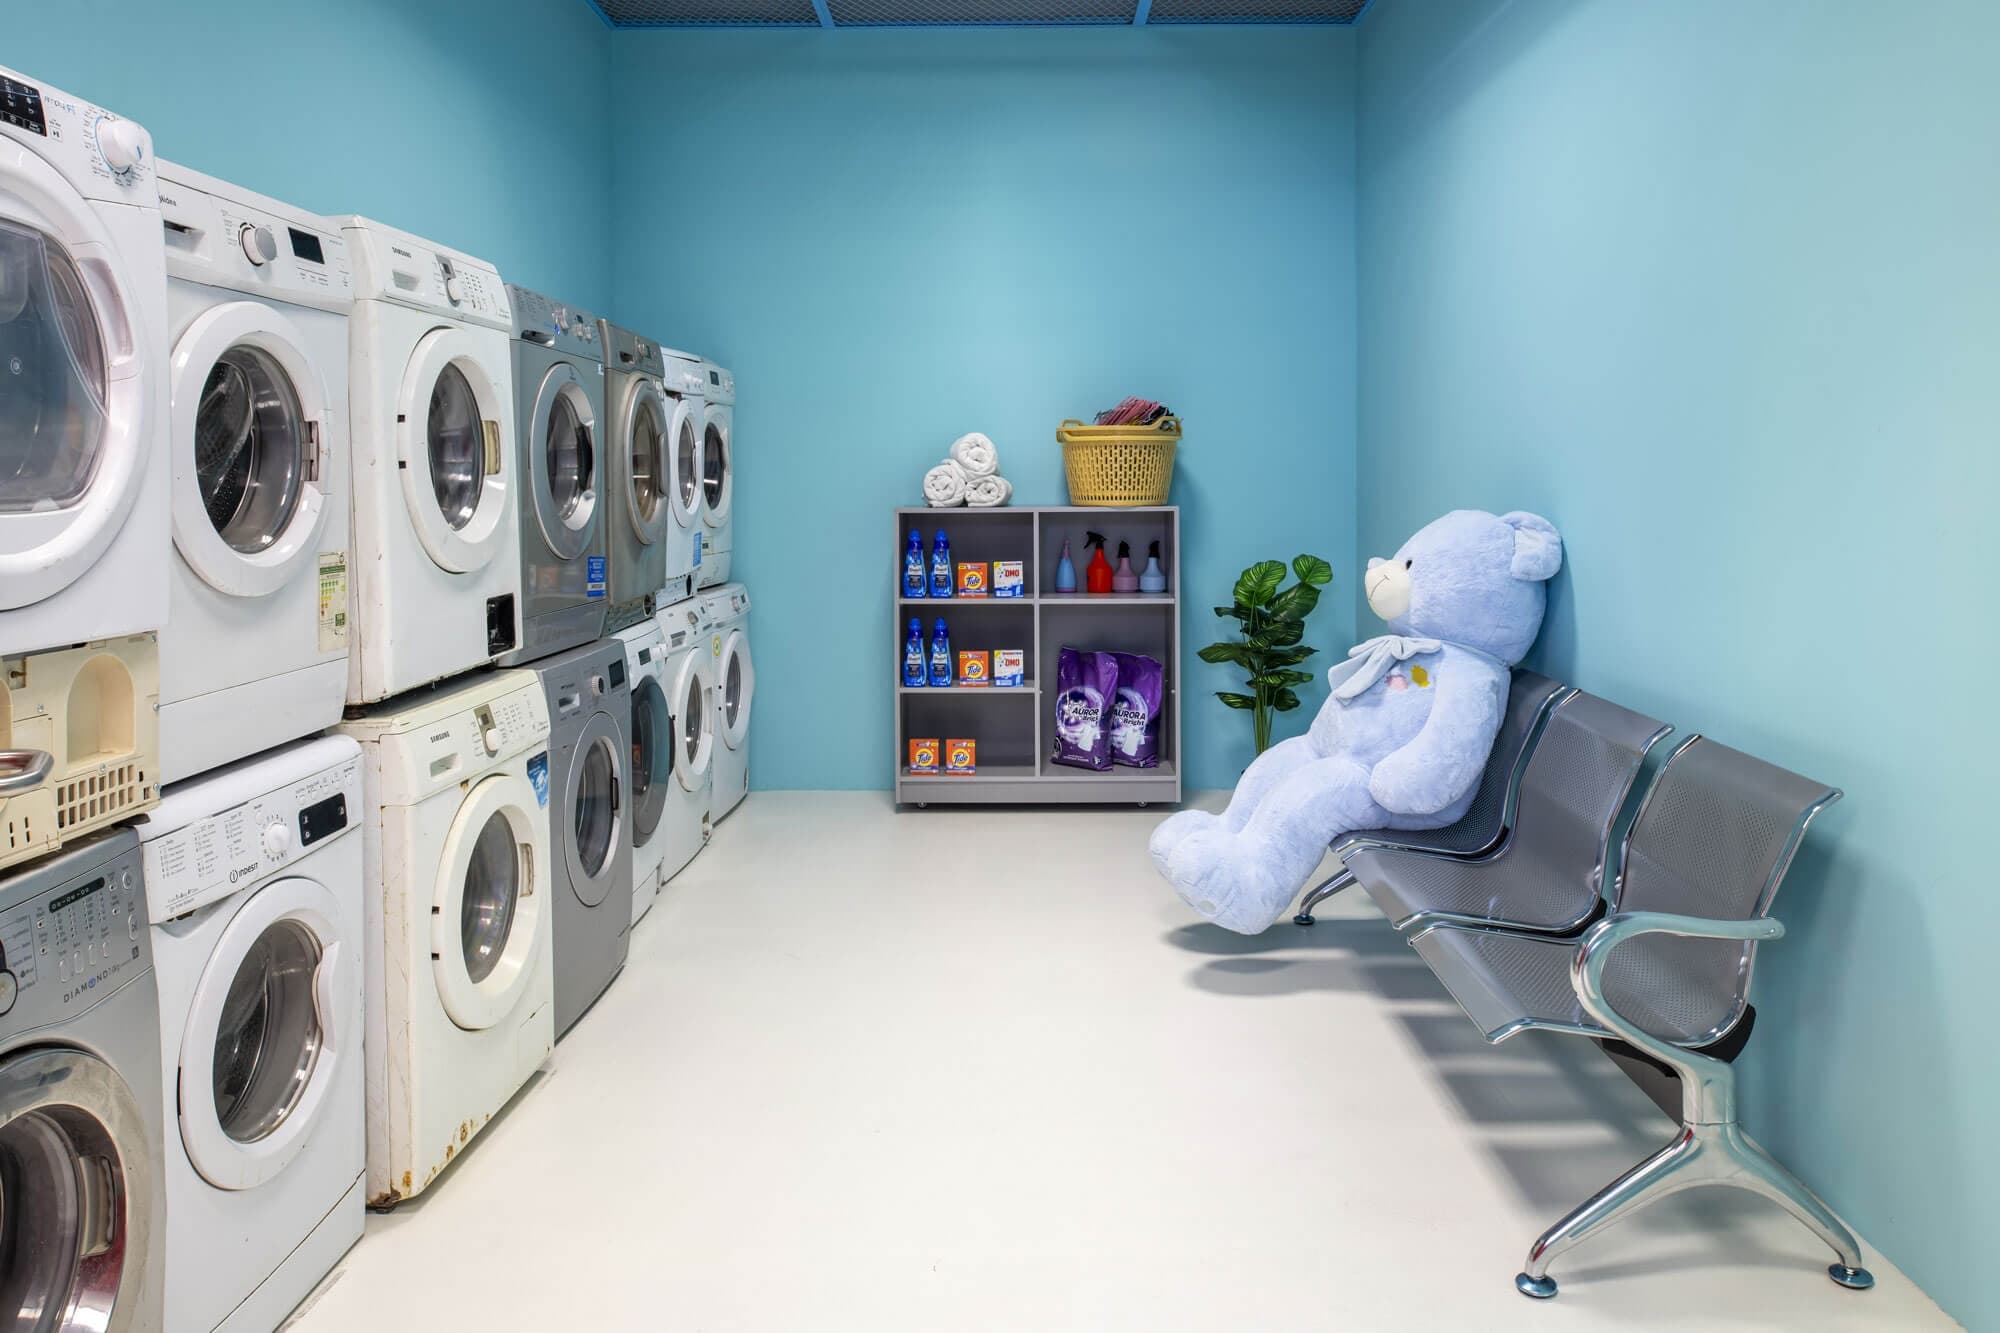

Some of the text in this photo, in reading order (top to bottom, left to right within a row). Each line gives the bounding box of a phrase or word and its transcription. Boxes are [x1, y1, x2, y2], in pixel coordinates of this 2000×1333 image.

[966, 575, 981, 586] Tide
[967, 665, 982, 676] Tide
[1113, 708, 1146, 720] AURORA
[1123, 718, 1144, 726] Bright
[430, 731, 450, 743] SAMSUNG
[917, 754, 932, 763] Tide
[953, 754, 968, 764] Tide
[64, 970, 107, 1003] DIAMOND
